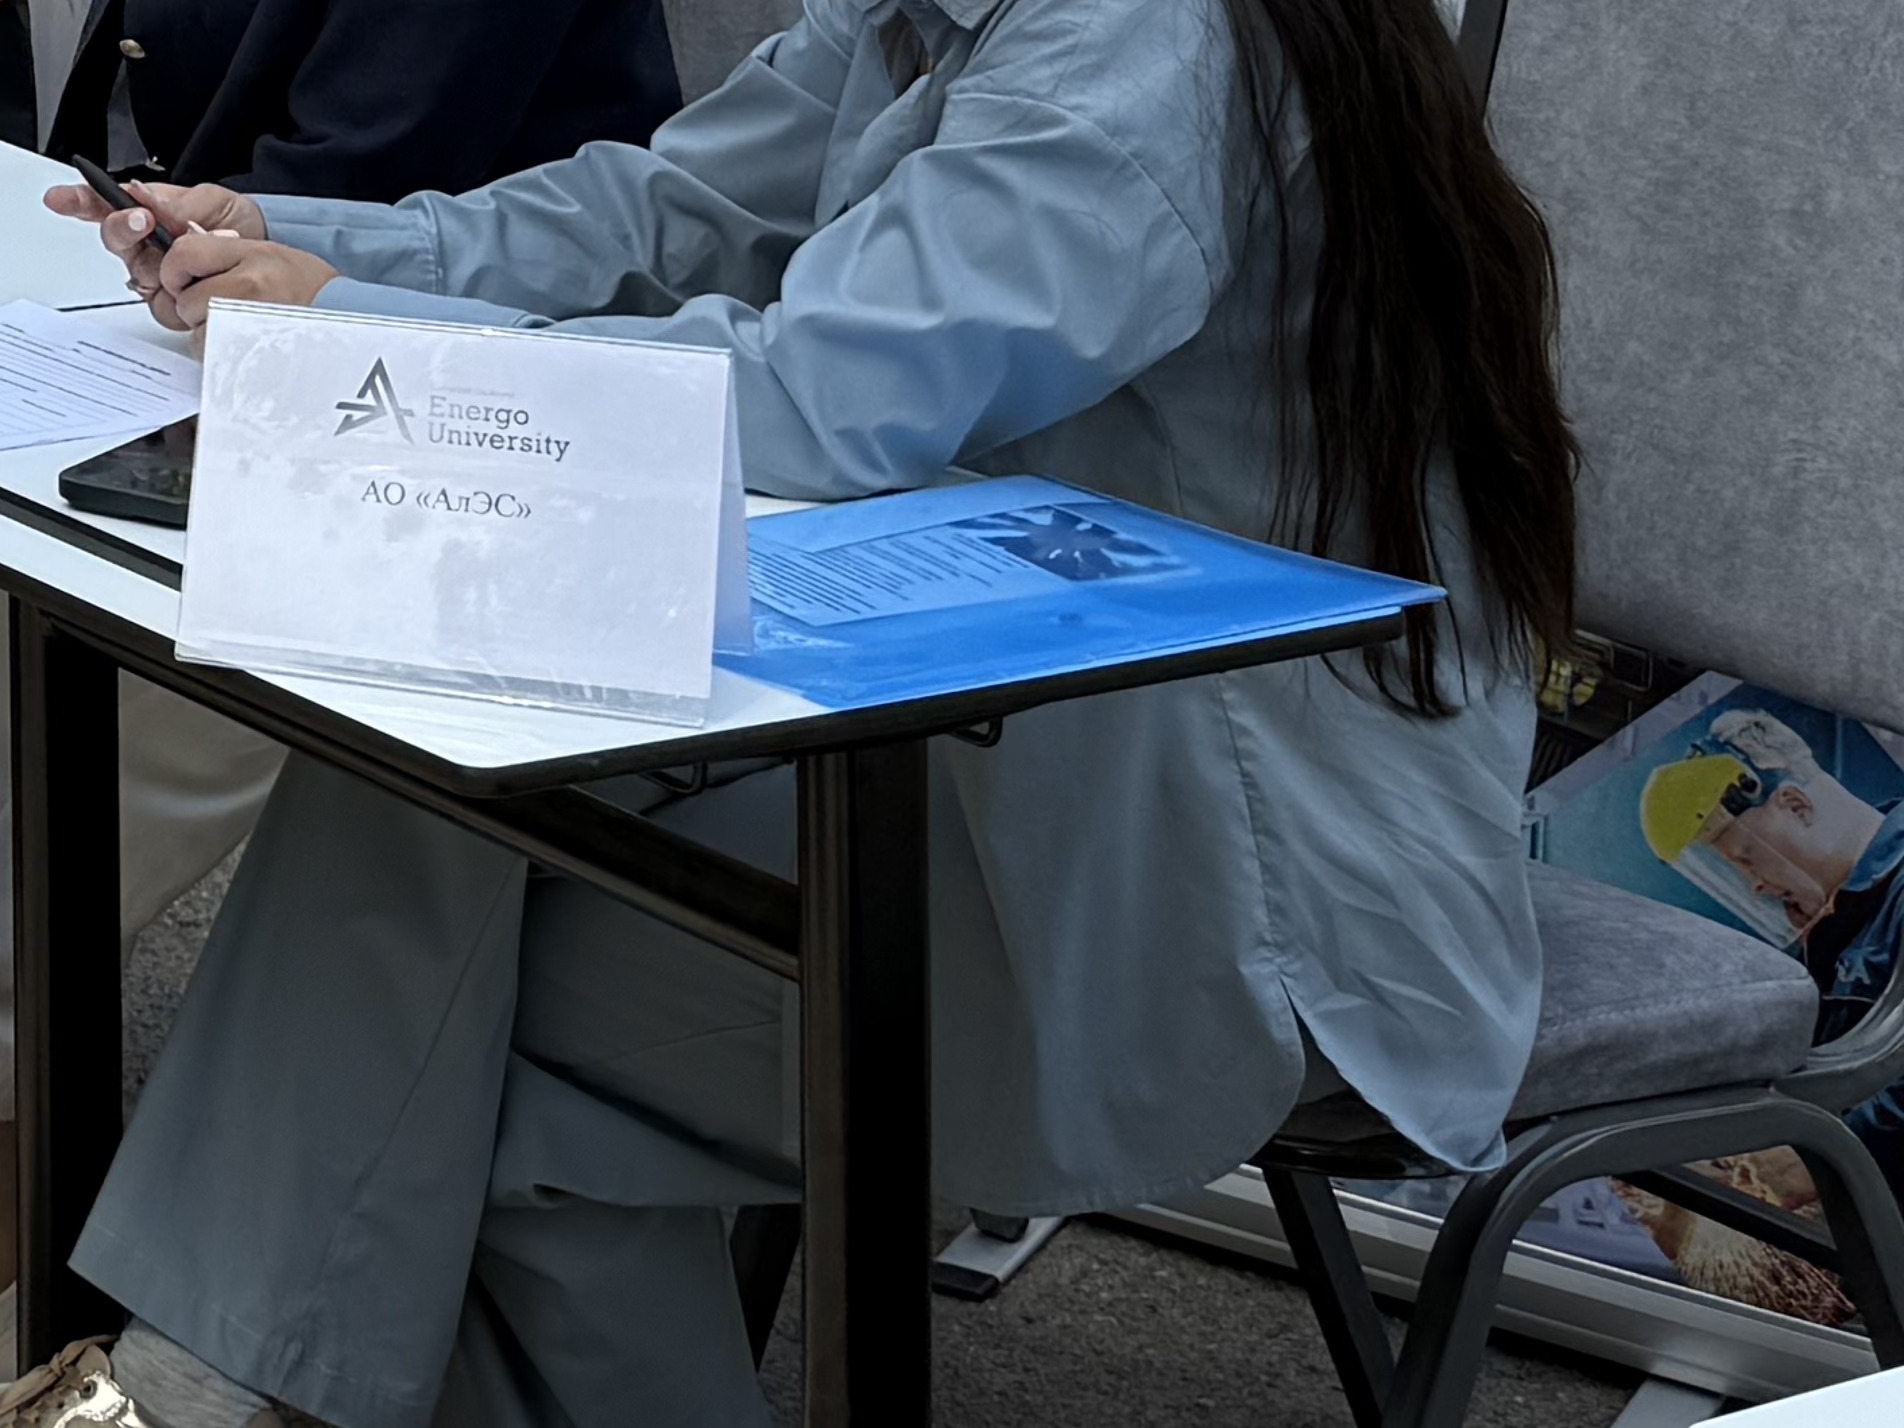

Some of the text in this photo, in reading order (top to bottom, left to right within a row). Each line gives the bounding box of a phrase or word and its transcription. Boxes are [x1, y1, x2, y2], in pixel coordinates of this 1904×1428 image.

[427, 395, 530, 430] Energo
[427, 421, 571, 463] University
[361, 480, 533, 519] АО «АлЭС»
